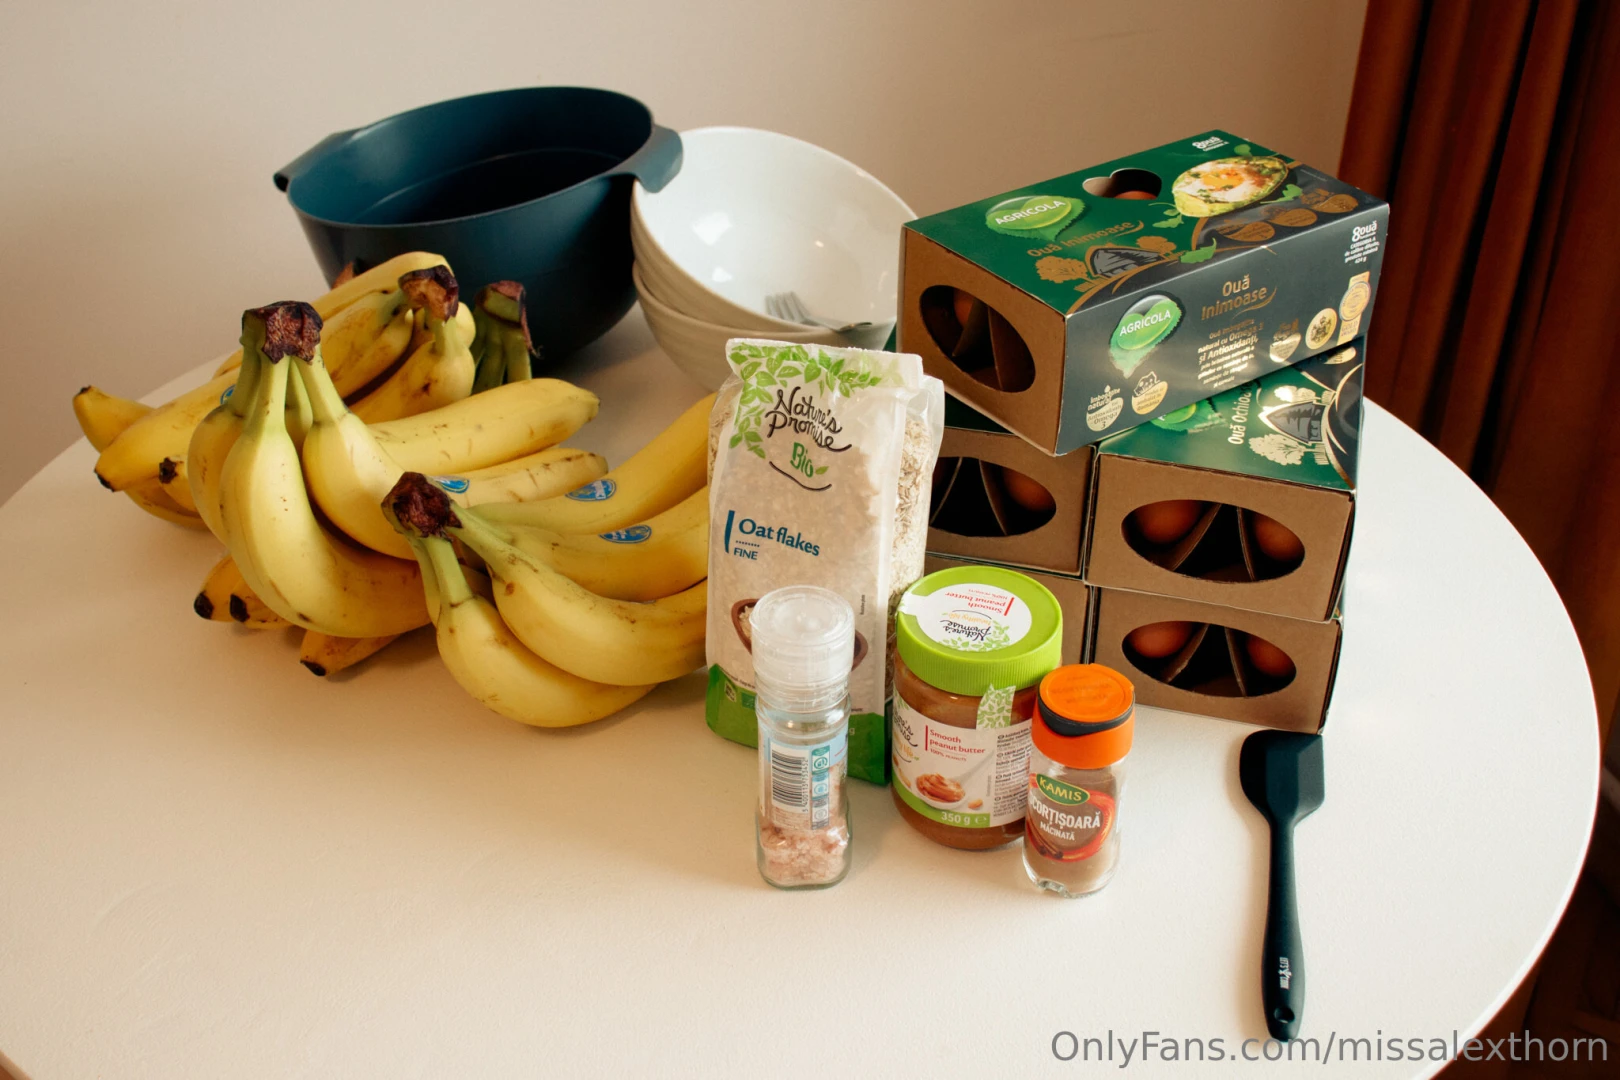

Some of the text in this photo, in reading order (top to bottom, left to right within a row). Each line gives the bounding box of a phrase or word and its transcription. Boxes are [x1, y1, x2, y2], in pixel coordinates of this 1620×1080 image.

[994, 200, 1066, 225] AGRICOLA
[1027, 222, 1135, 257] Ouă Inimoase
[1222, 274, 1250, 296] Ouă
[1202, 287, 1267, 320] Inimoase
[1120, 310, 1171, 336] AGRICOLA
[774, 386, 842, 434] Nature's
[1228, 382, 1252, 444] Ouă Ochioa
[765, 410, 852, 452] Promise
[790, 442, 814, 478] Bio
[738, 519, 820, 556] Oat flakes
[734, 548, 758, 560] FINE
[945, 591, 974, 601] butter
[968, 602, 1002, 614] Smooth
[930, 729, 961, 743] Smooth
[930, 739, 985, 753] peanut butter
[1040, 777, 1082, 801] KAMIS
[941, 812, 970, 826] 350 g
[1040, 821, 1075, 841] MĂCINATĂ
